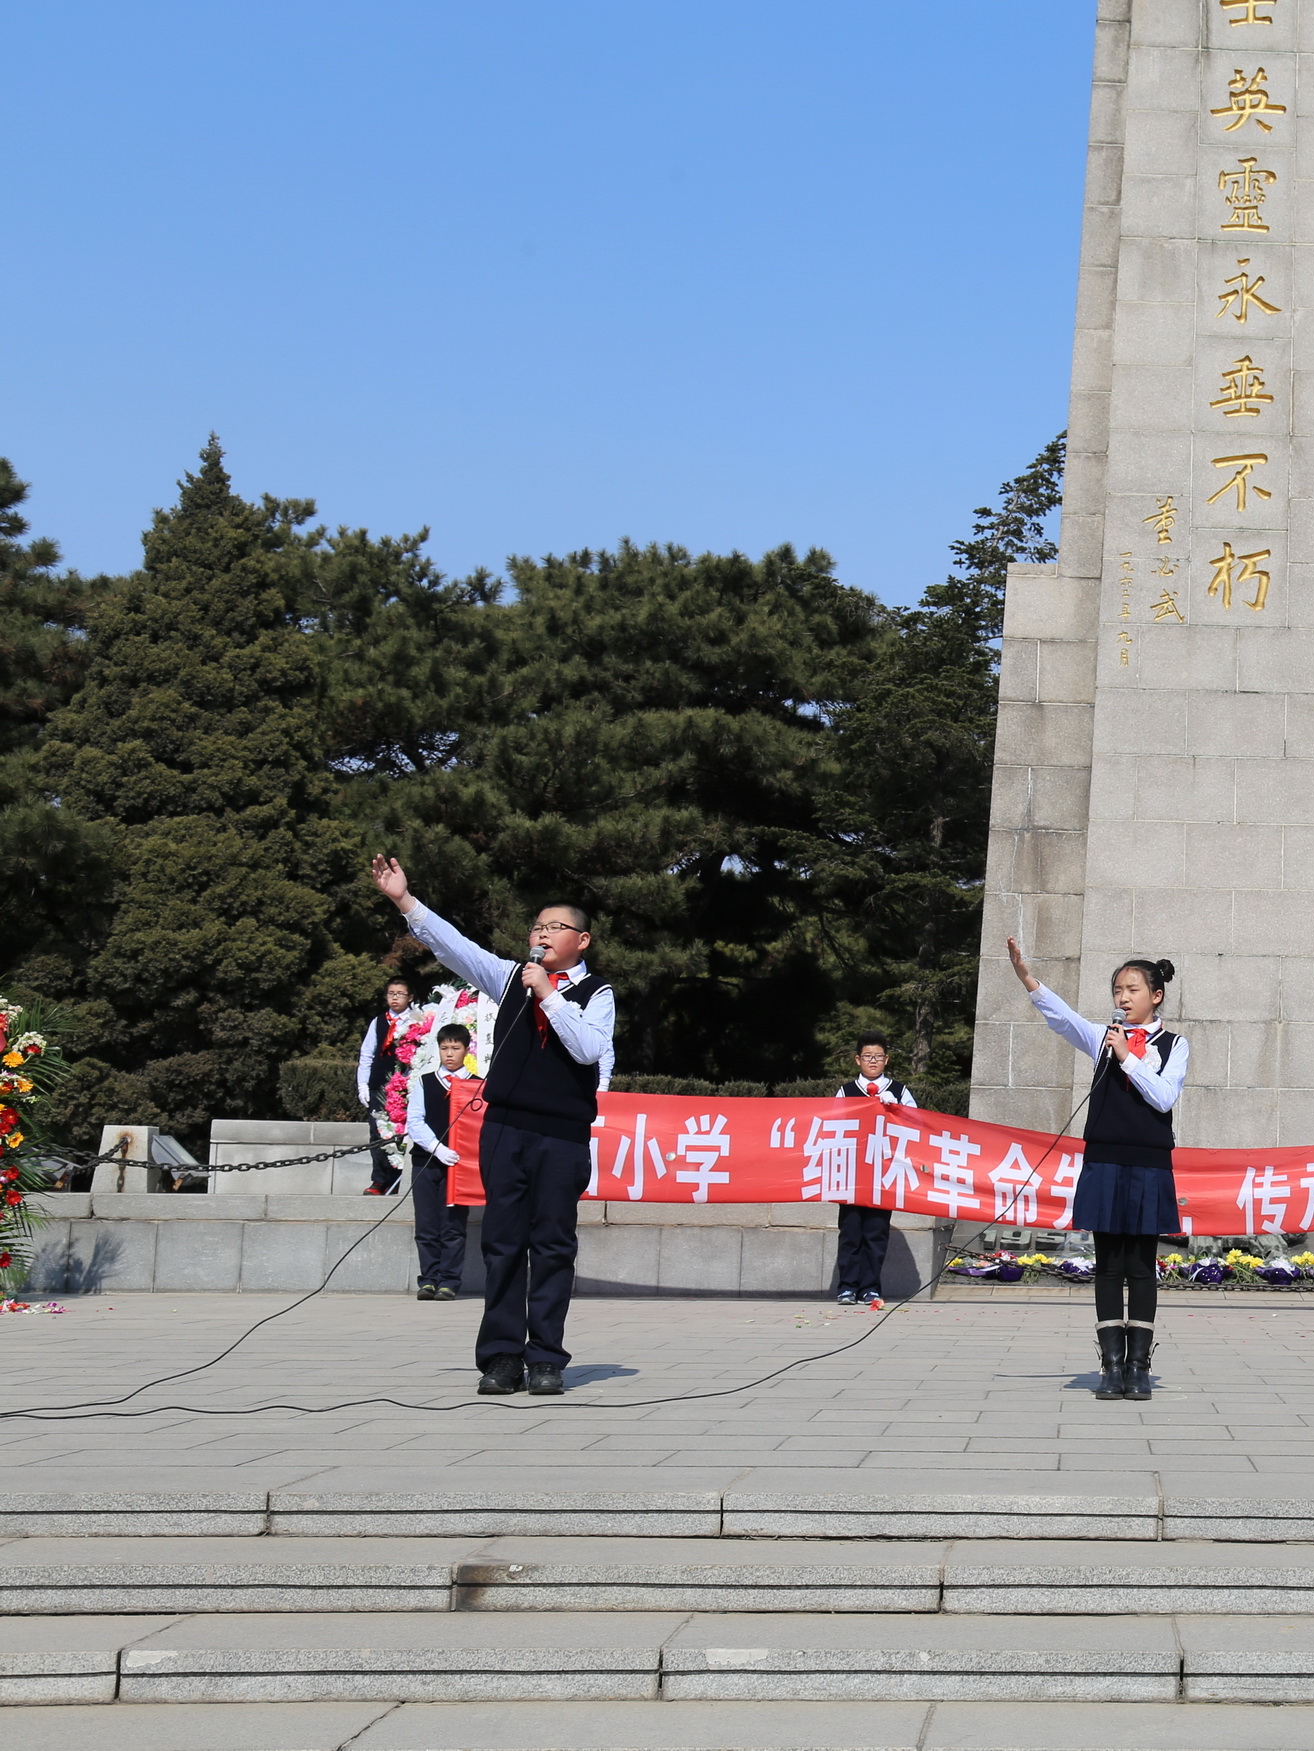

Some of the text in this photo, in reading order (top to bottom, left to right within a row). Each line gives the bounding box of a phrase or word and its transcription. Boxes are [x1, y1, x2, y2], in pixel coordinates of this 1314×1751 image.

[1116, 551, 1135, 667] 一九六二年九月
[1142, 495, 1185, 623] 董必武
